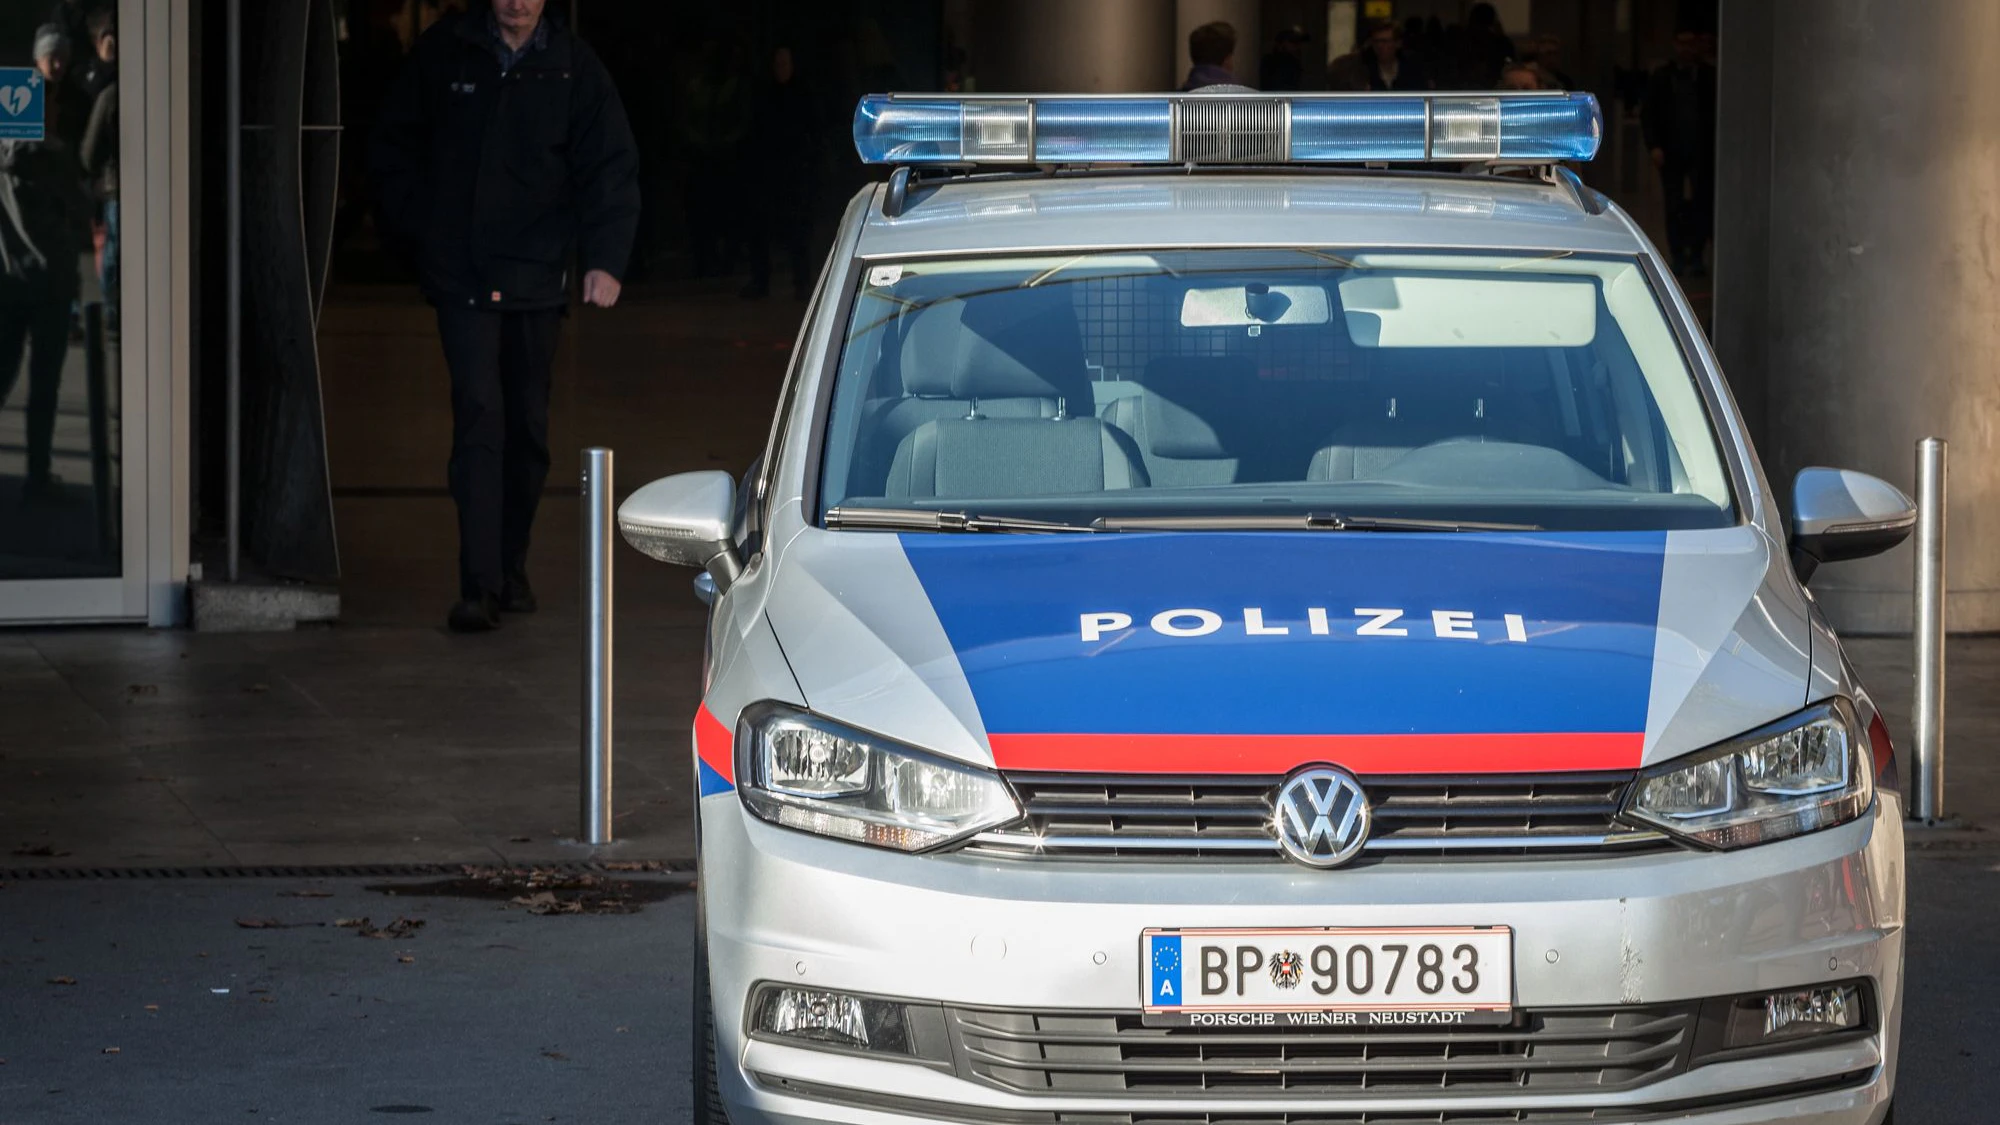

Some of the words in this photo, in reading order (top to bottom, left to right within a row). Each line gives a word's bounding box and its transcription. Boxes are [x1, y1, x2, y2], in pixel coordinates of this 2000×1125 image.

[1080, 607, 1528, 642] POLIZEI
[1277, 769, 1367, 865] VW
[1200, 945, 1264, 996] BP
[1310, 943, 1480, 996] 90783
[1159, 979, 1174, 997] A
[1190, 1013, 1275, 1026] PORSCHE
[1287, 1012, 1357, 1025] WIENER
[1368, 1011, 1466, 1025] NEUSTADT
